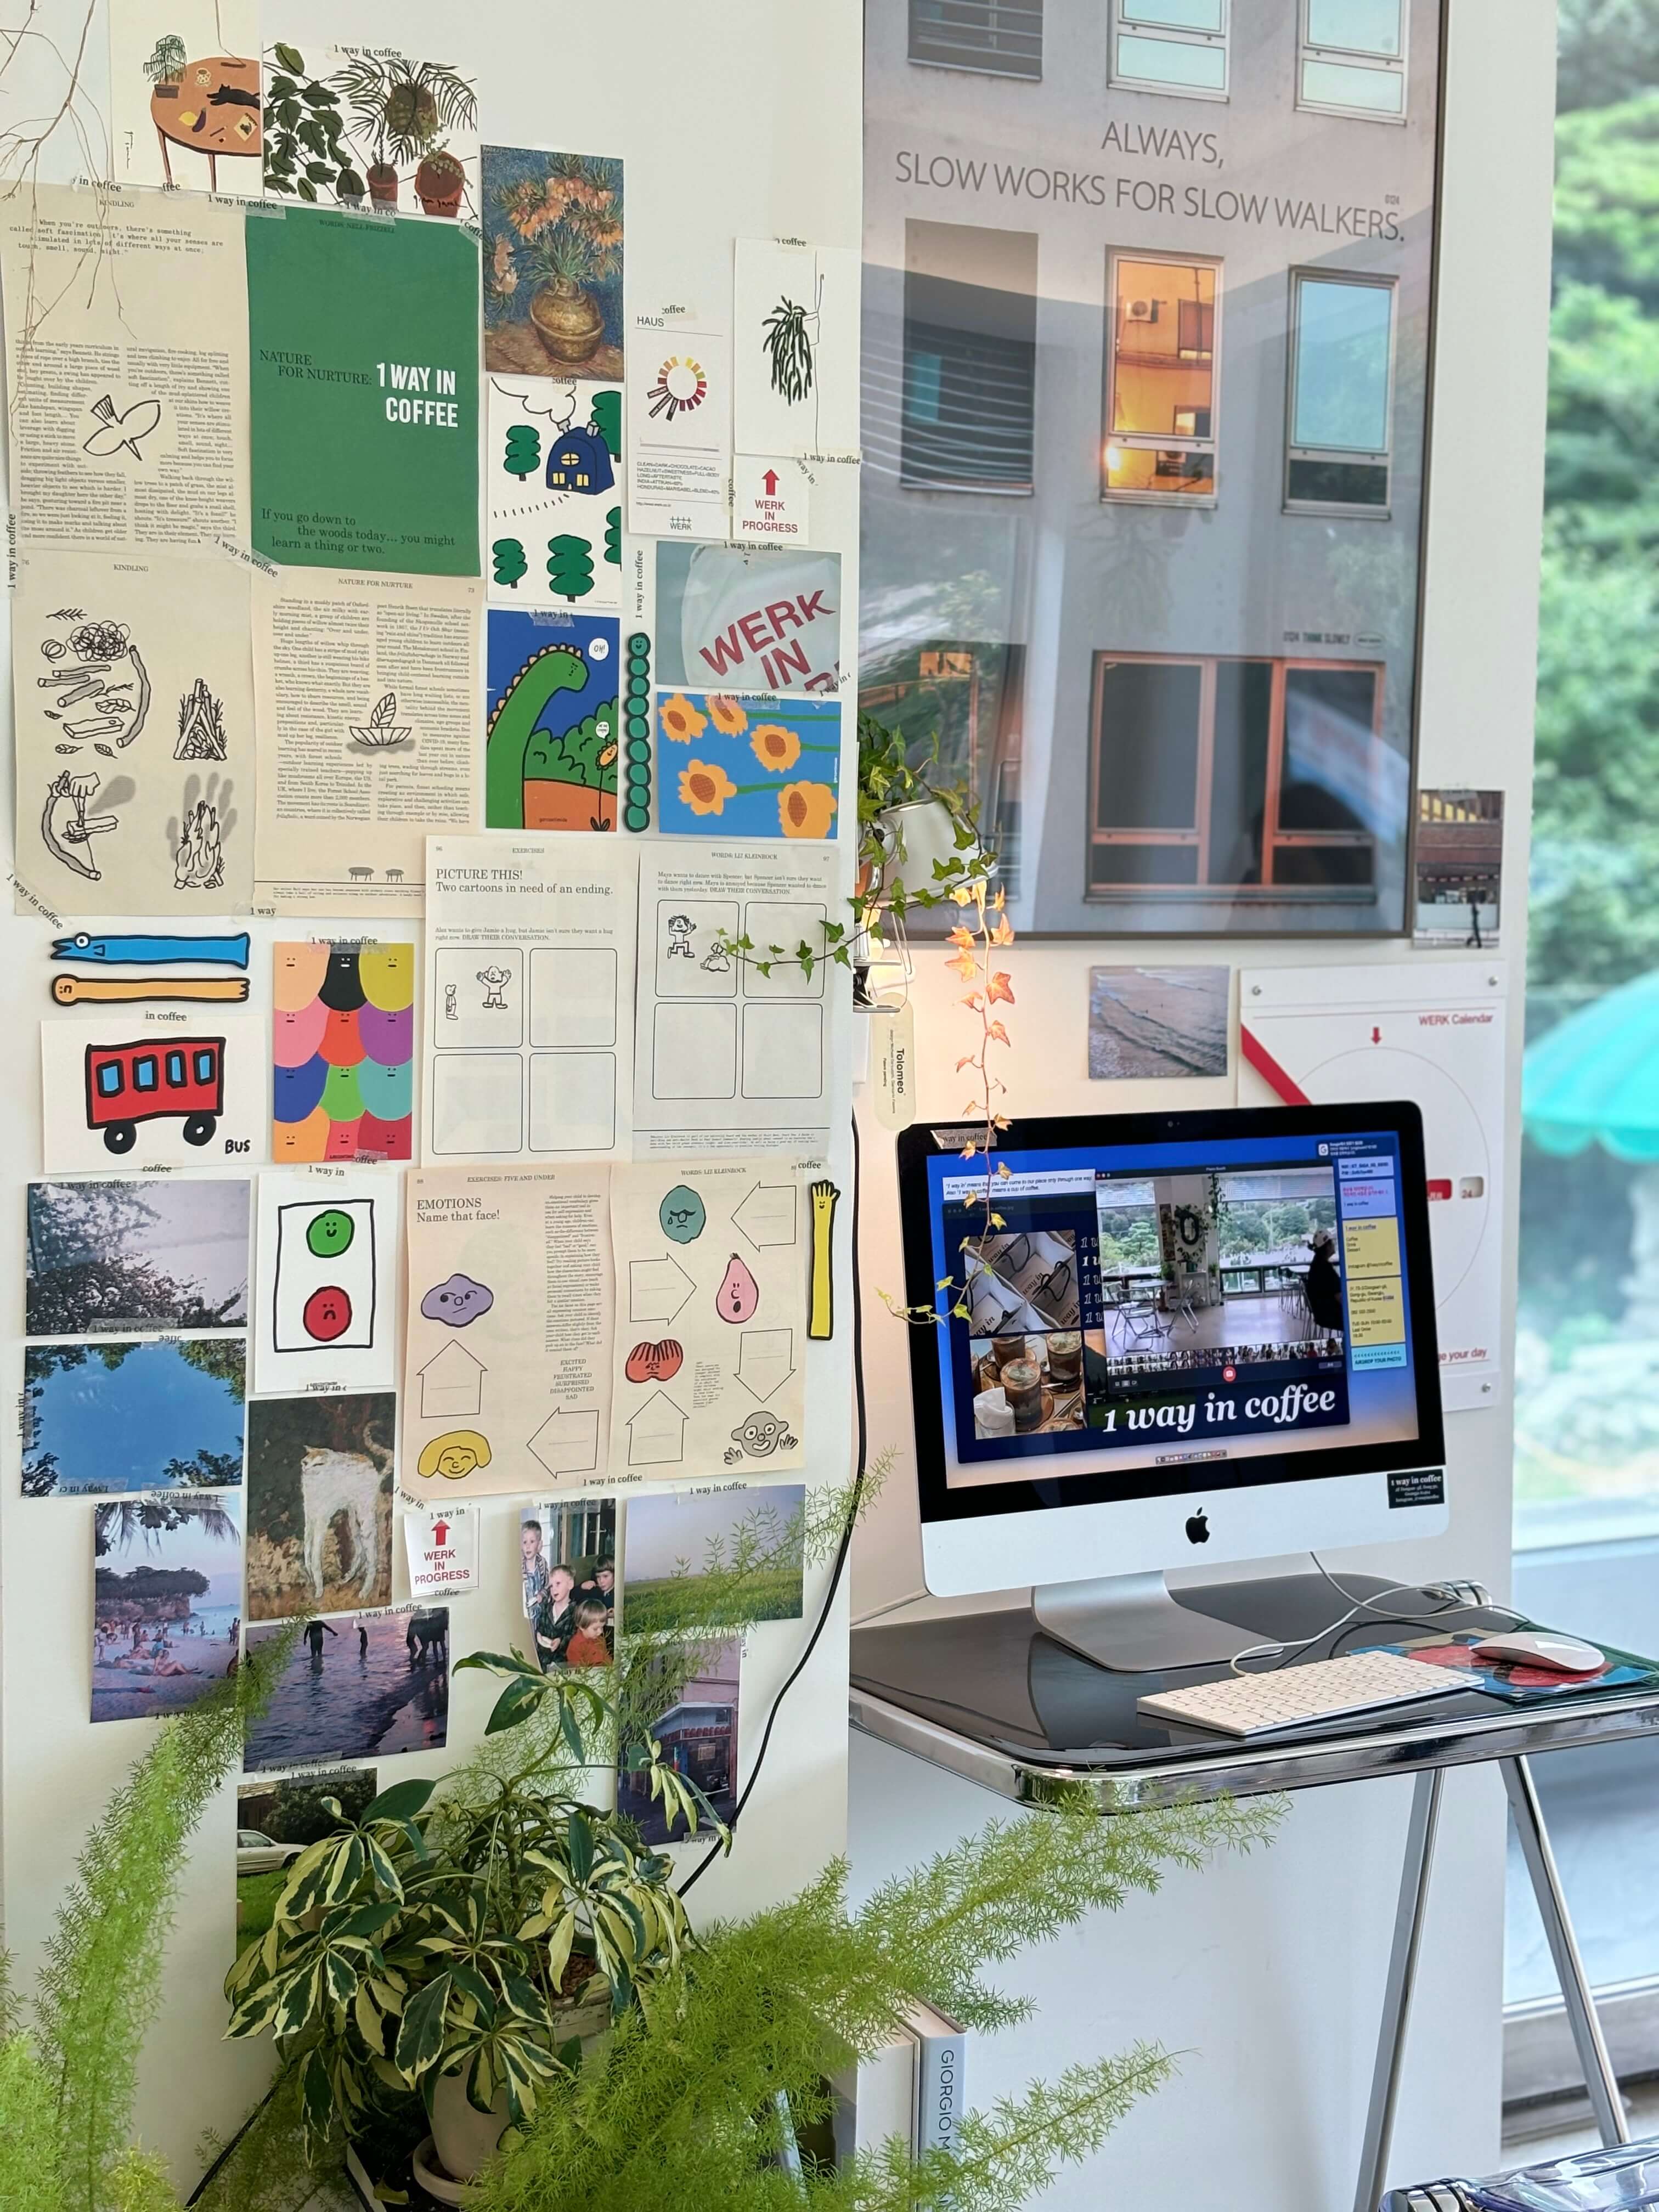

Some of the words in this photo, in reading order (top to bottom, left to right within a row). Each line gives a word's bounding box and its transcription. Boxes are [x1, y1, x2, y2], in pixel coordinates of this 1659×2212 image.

[335, 44, 339, 54] 1
[341, 46, 361, 57] way
[364, 47, 373, 55] in
[375, 47, 402, 58] coffee
[1101, 121, 1224, 170] ALWAYS,
[895, 151, 987, 192] SLOW
[994, 163, 1106, 206] WORKS
[1116, 179, 1175, 215] FOR
[1183, 187, 1269, 223] SLOW
[1274, 198, 1404, 242] WALKERS.
[215, 197, 234, 206] way
[236, 197, 246, 206] in
[248, 200, 277, 209] coffee
[126, 225, 153, 234] there's
[157, 228, 191, 237] something
[782, 237, 806, 247] coffee
[637, 316, 664, 326] HAUS
[259, 349, 312, 366] NATURE
[278, 365, 303, 377] FOR
[307, 369, 372, 385] NURTURE:
[377, 363, 386, 387] 1
[391, 364, 430, 392] WAY
[437, 369, 456, 396] IN
[386, 397, 459, 427] COFFEE
[810, 455, 823, 463] way
[837, 456, 860, 464] coffee
[755, 500, 785, 510] WERK
[262, 509, 272, 520] If
[273, 511, 293, 522] you
[297, 514, 309, 524] go
[312, 512, 342, 524] down
[345, 516, 356, 526] to
[765, 512, 775, 521] IN
[8, 514, 16, 543] coffee
[742, 521, 798, 533] PROGRESS
[297, 526, 315, 536] the
[319, 528, 353, 539] woods
[356, 529, 398, 543] today...
[401, 535, 419, 545] you
[424, 535, 455, 546] might
[8, 545, 16, 555] in
[272, 537, 300, 548] learn
[304, 541, 311, 549] a
[314, 539, 343, 553] thing
[347, 544, 359, 552] or
[362, 544, 385, 555] two.
[730, 543, 747, 551] way
[215, 536, 221, 545] 1
[222, 541, 240, 557] way
[240, 549, 250, 562] in
[251, 557, 278, 579] coffee
[7, 557, 18, 580] way
[113, 563, 149, 573] KINDLING
[338, 578, 365, 586] NATURE
[381, 580, 413, 589] NURTURE
[635, 580, 642, 589] in
[699, 590, 837, 676] WERK
[594, 645, 605, 653] OH!
[760, 639, 811, 689] IN
[725, 694, 740, 703] way
[436, 868, 488, 879] PICTURE
[492, 870, 523, 881] THIS!
[436, 882, 456, 892] Two
[459, 884, 503, 893] cartoons
[506, 883, 516, 893] in
[521, 884, 544, 893] need
[547, 884, 558, 893] of
[560, 885, 572, 894] an
[575, 884, 613, 896] ending.
[13, 880, 31, 899] way
[29, 895, 38, 905] in
[36, 904, 64, 930] coffee
[319, 938, 335, 947] way
[349, 936, 378, 946] coffee
[145, 1011, 156, 1020] in
[157, 1011, 188, 1022] coffee
[1419, 1015, 1449, 1025] WERK
[1452, 1013, 1493, 1024] Calendar
[896, 1048, 905, 1093] Tolomeo
[224, 1139, 251, 1154] BUS
[143, 1164, 172, 1173] coffee
[798, 1161, 821, 1169] coffee
[1462, 1190, 1472, 1198] 24
[417, 1198, 482, 1210] EMOTIONS
[417, 1211, 448, 1222] Name
[451, 1211, 472, 1221] that
[476, 1210, 500, 1220] face!
[101, 1325, 121, 1334] way
[1449, 1351, 1469, 1362] your
[1471, 1347, 1488, 1358] day
[1103, 1409, 1116, 1432] 1
[1126, 1404, 1196, 1432] way
[1206, 1393, 1238, 1421] in
[1245, 1384, 1335, 1424] coffee
[589, 1478, 605, 1487] way
[608, 1476, 616, 1484] in
[618, 1474, 642, 1483] coffee
[696, 1486, 711, 1495] way
[713, 1484, 721, 1492] in
[723, 1482, 747, 1491] coffee
[424, 1549, 456, 1561] WERK
[435, 1562, 445, 1571] IN
[415, 1570, 470, 1585] PROGRESS
[435, 1588, 460, 1596] coffee
[367, 1609, 384, 1618] way
[385, 1606, 394, 1615] in
[396, 1603, 422, 1613] coffee
[939, 2050, 954, 2131] GIORGIO
